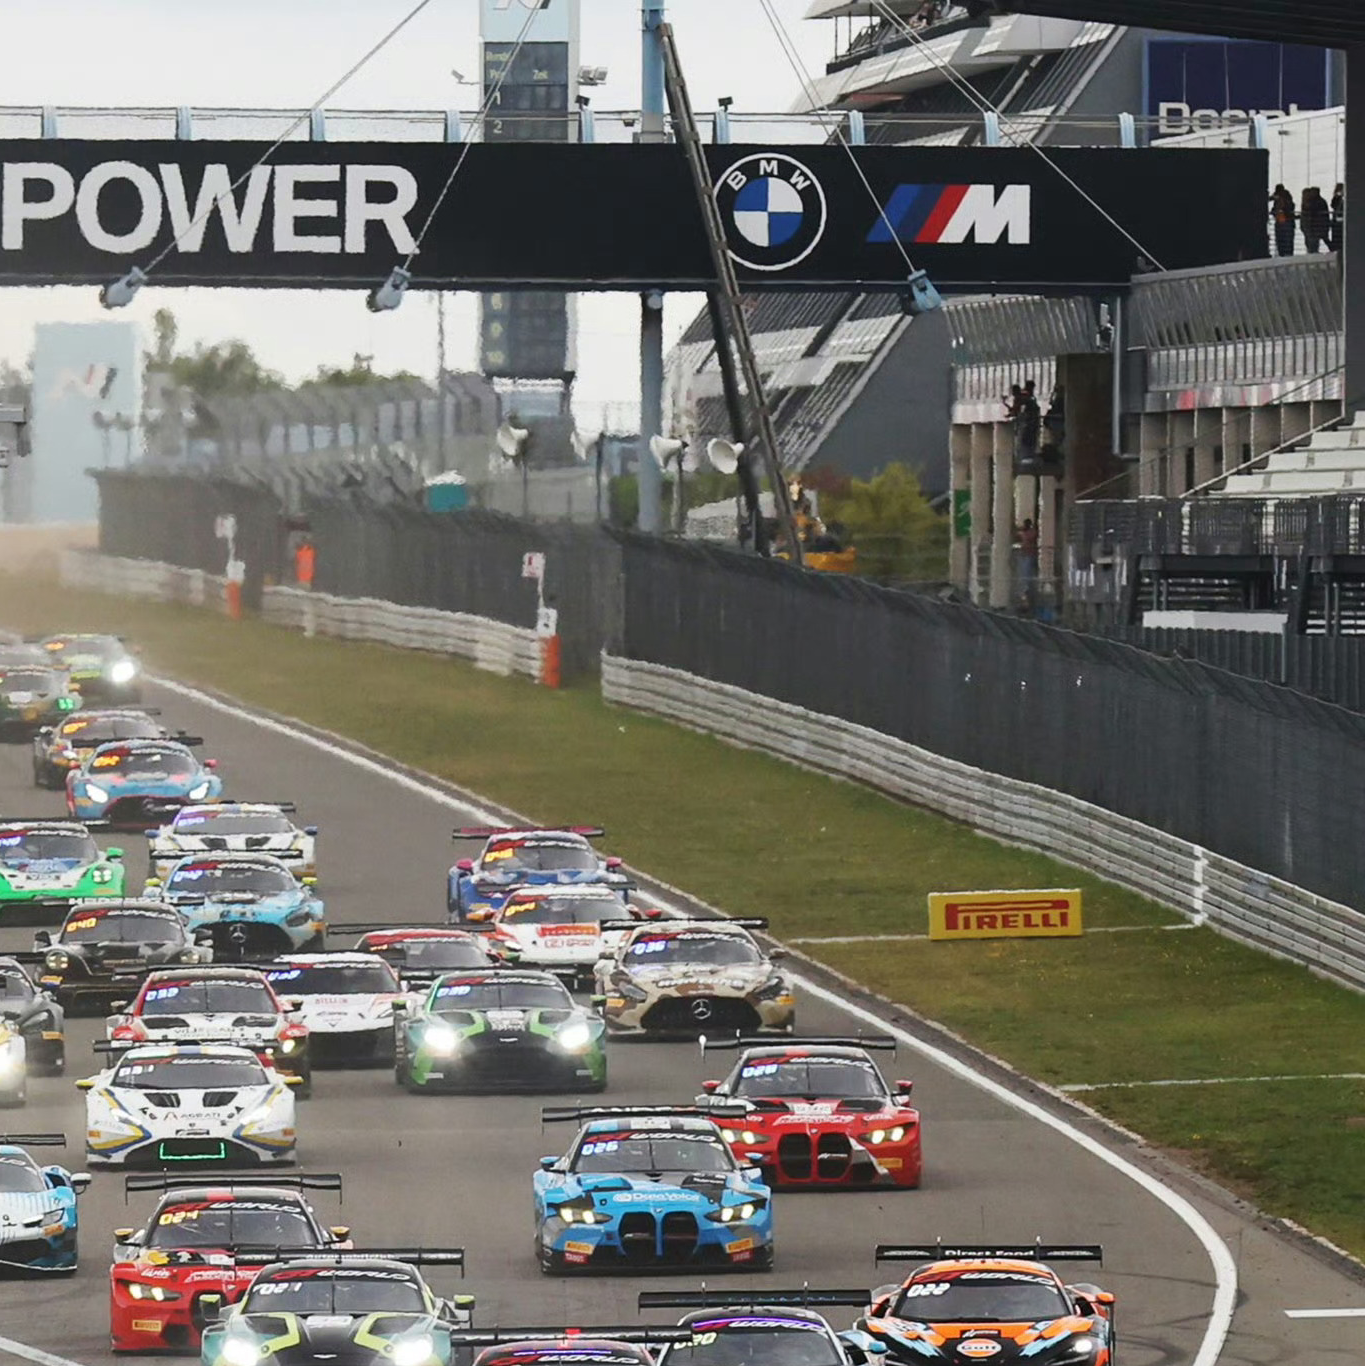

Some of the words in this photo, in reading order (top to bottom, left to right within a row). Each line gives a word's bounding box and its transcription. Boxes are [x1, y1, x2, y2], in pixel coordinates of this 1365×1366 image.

[726, 159, 812, 190] BMW
[1, 160, 421, 256] POWER
[945, 900, 1069, 931] PIRELLI
[906, 1283, 951, 1297] 022
